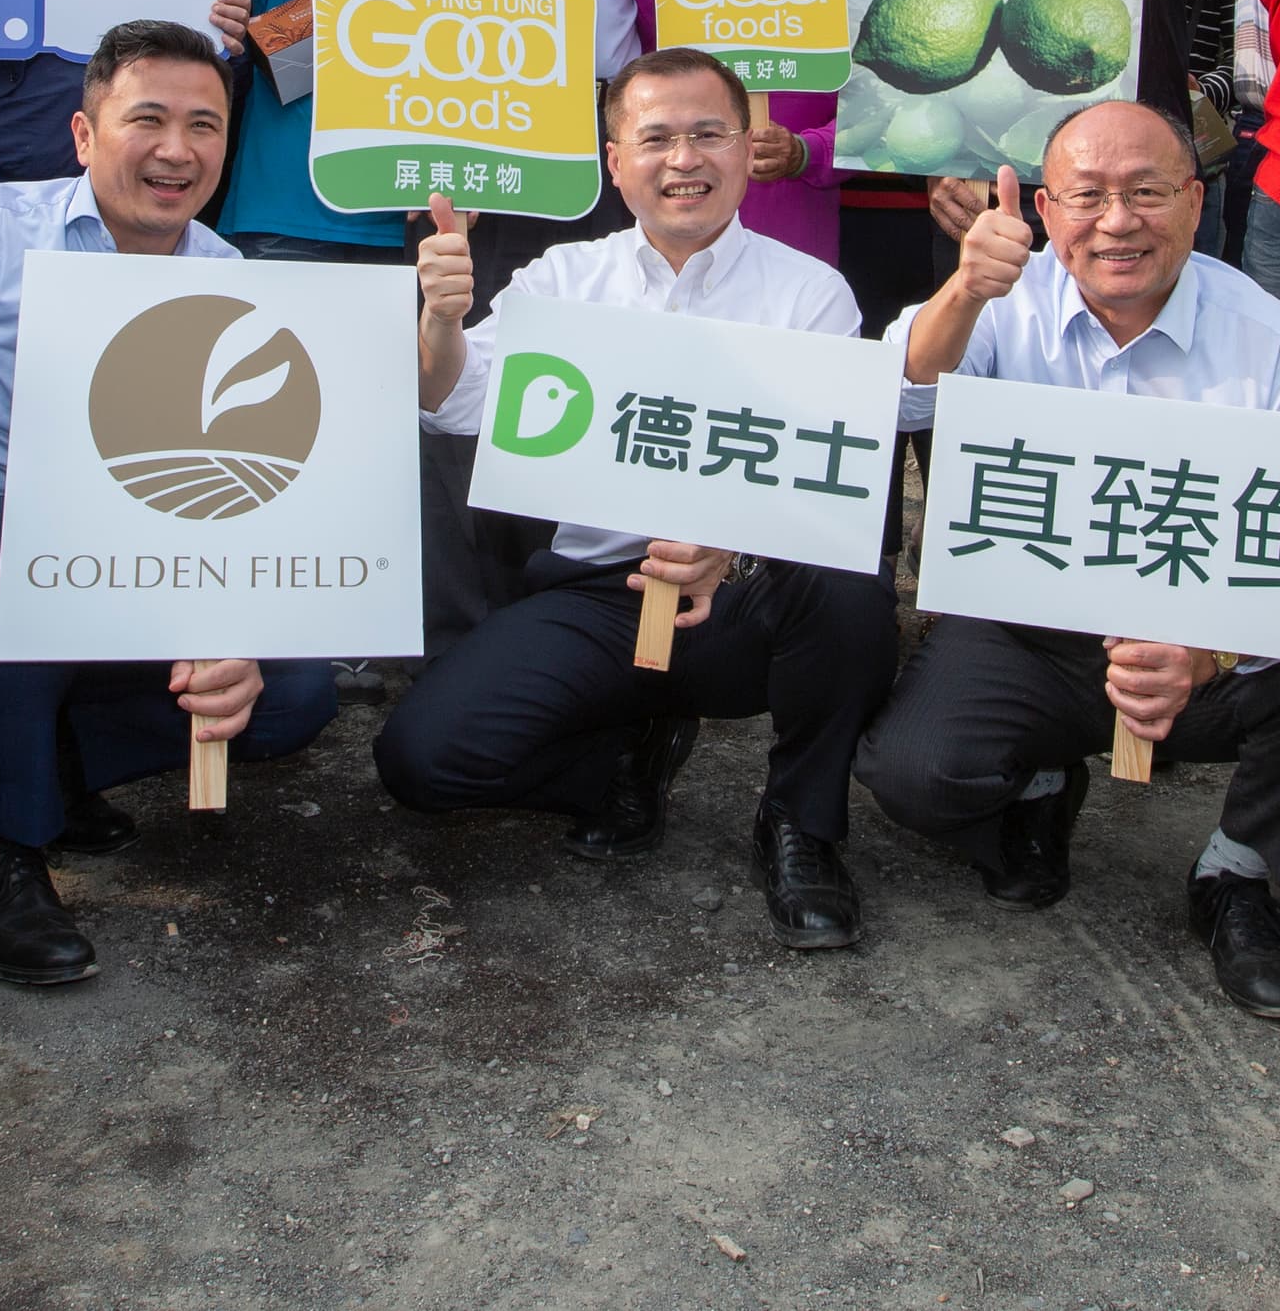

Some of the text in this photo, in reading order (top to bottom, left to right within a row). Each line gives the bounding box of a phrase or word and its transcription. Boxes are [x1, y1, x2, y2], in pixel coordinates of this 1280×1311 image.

[701, 9, 804, 40] food's
[721, 58, 797, 80] 東好物
[384, 83, 533, 132] food's
[394, 159, 522, 194] 屏東好物
[611, 390, 880, 500] 德克士
[27, 554, 227, 589] GOLDEN
